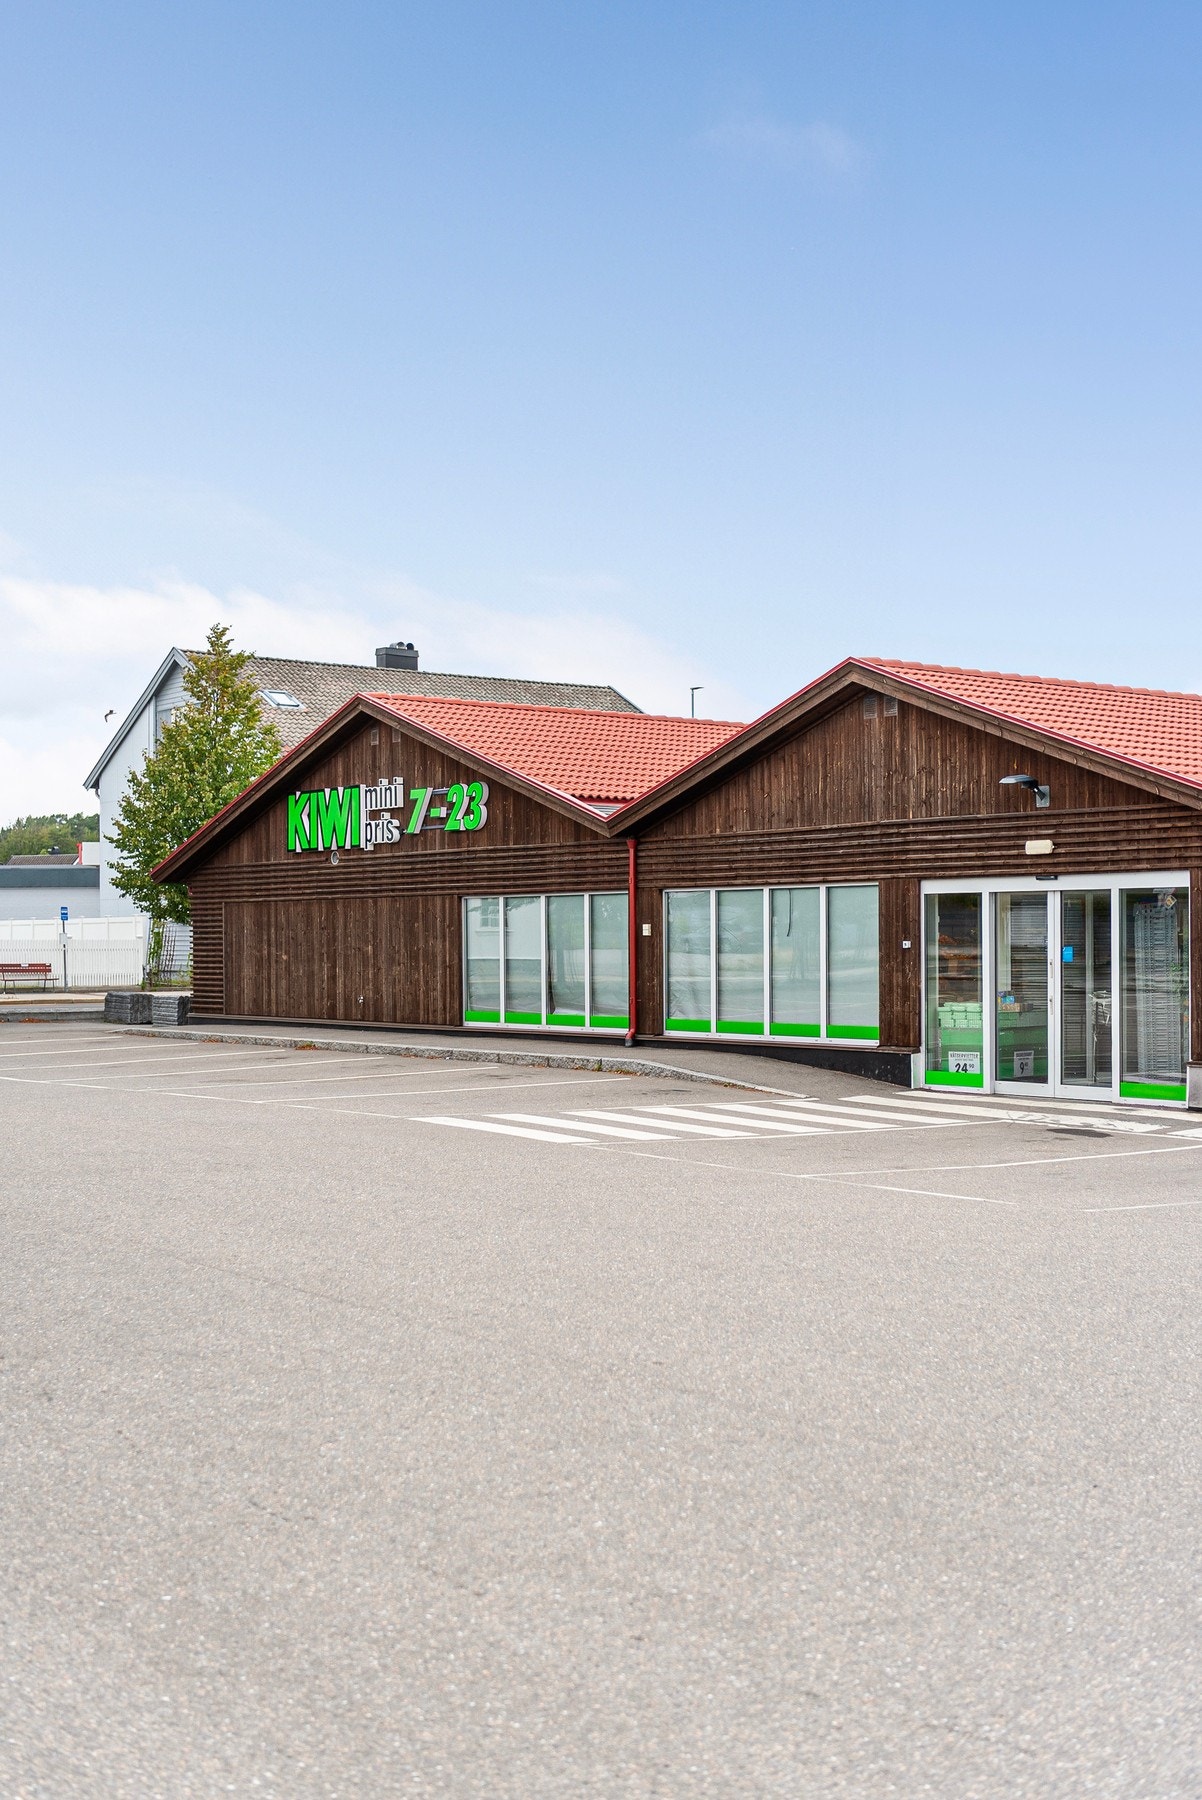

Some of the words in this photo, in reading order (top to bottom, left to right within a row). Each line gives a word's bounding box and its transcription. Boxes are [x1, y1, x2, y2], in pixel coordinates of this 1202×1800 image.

[364, 778, 401, 810] mini
[406, 781, 486, 834] 7-23
[287, 785, 361, 852] KIWI
[364, 813, 396, 849] pris
[955, 1062, 969, 1074] 24
